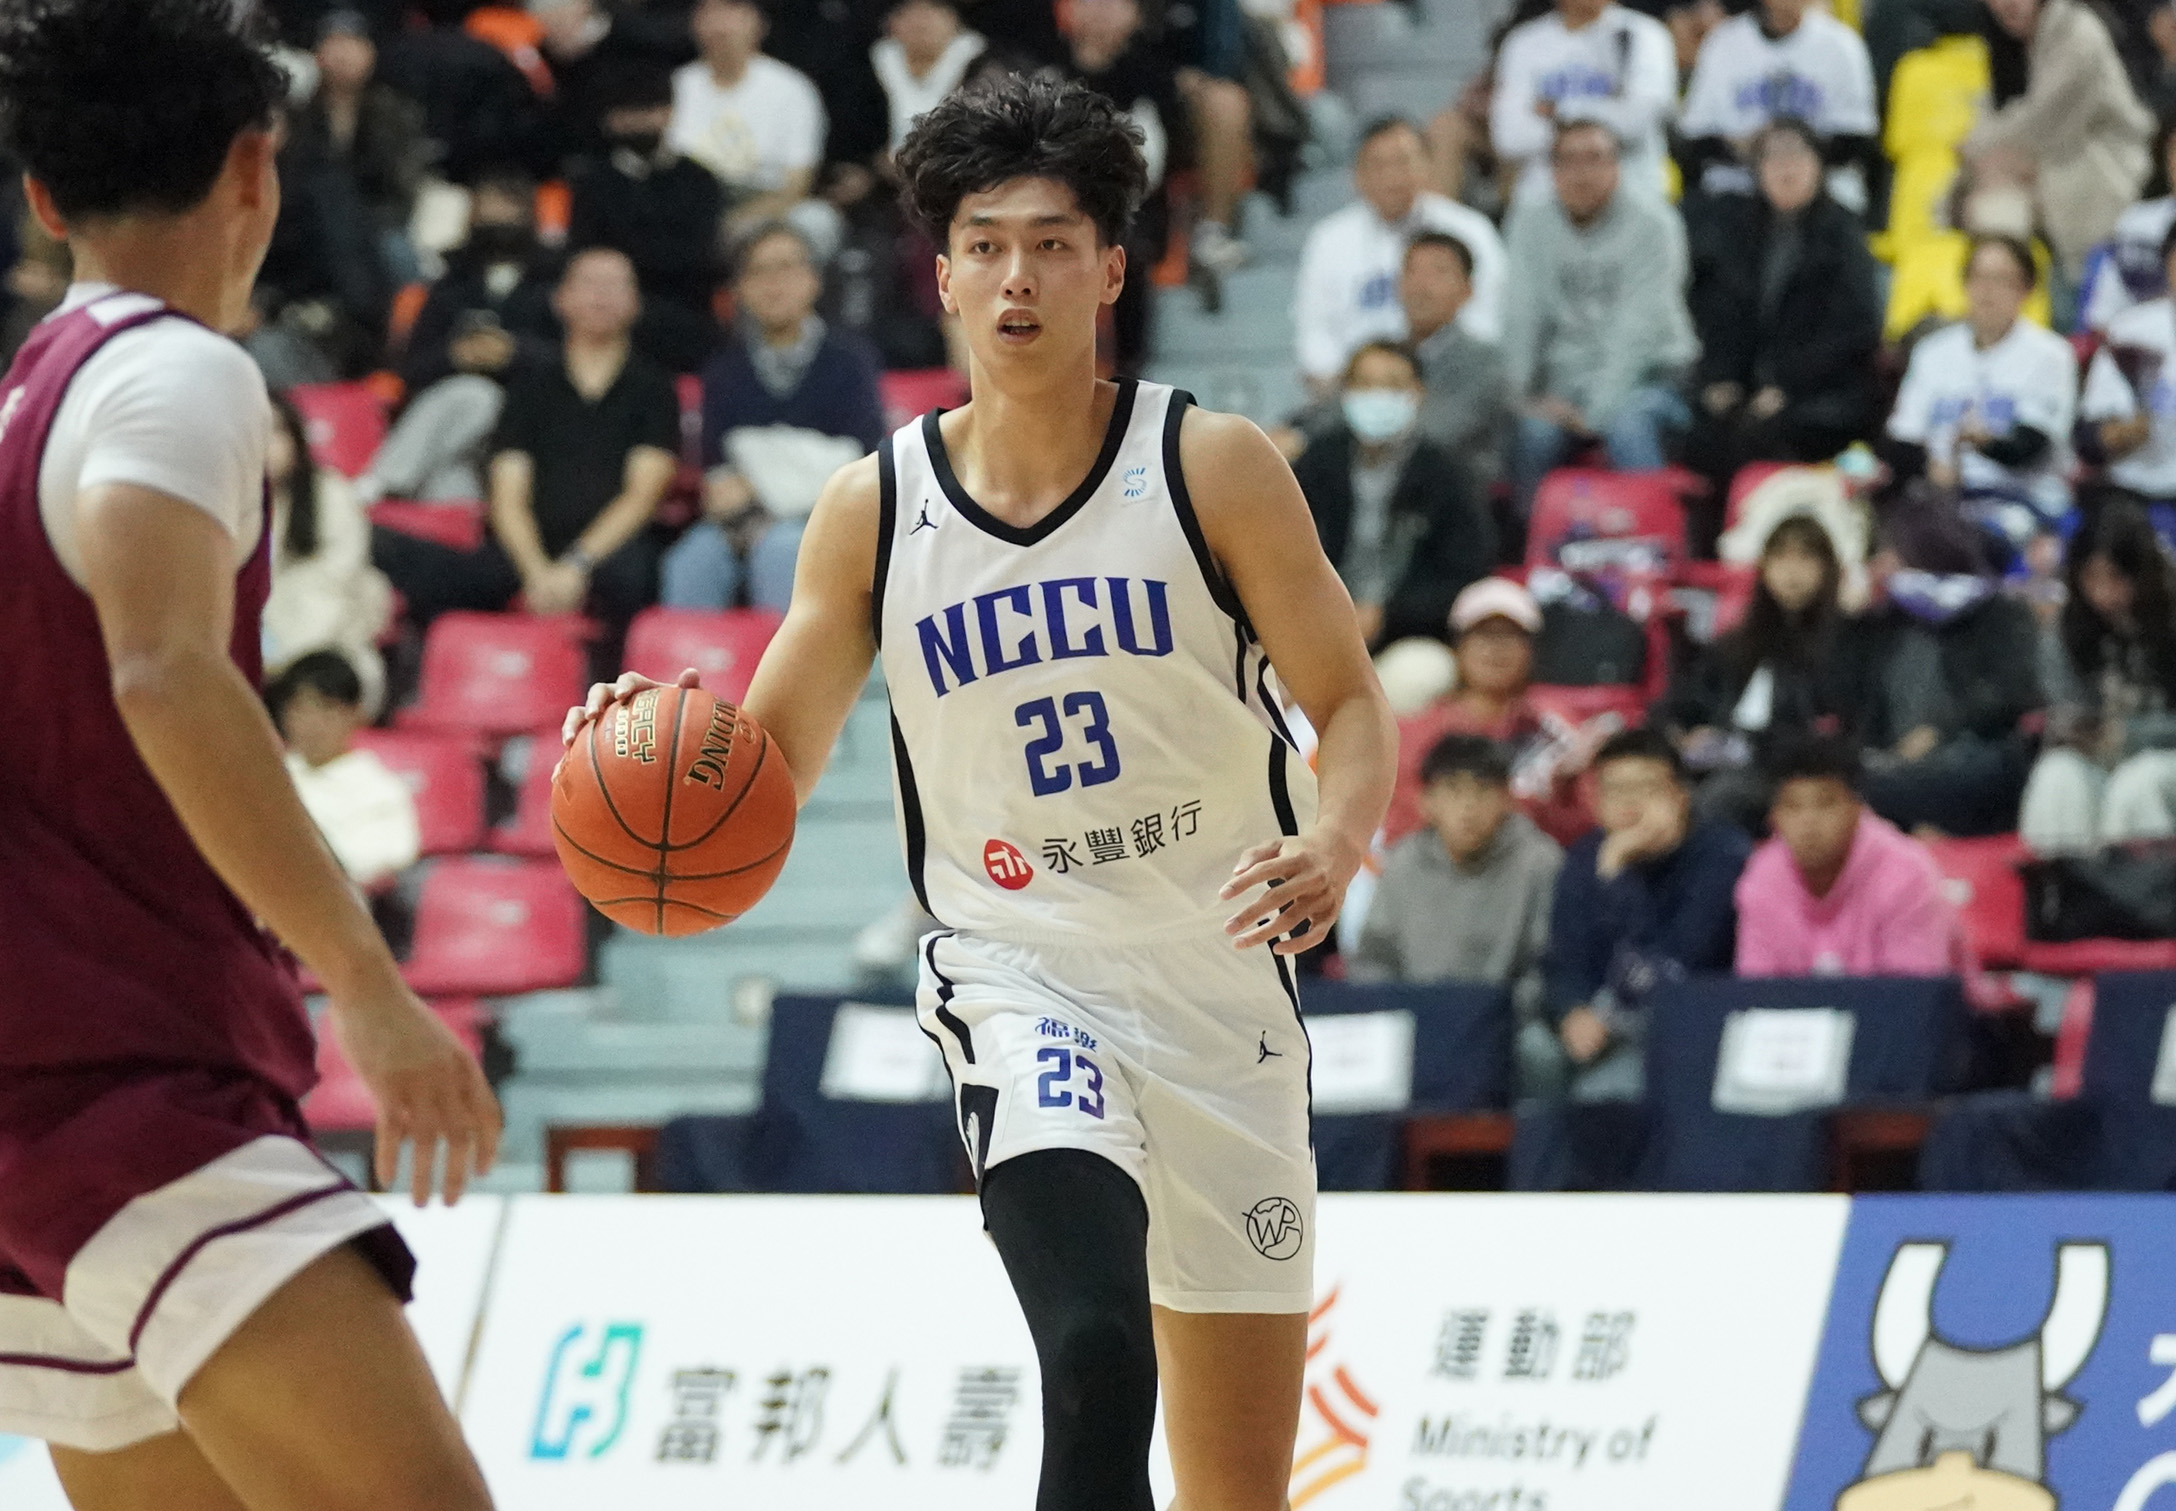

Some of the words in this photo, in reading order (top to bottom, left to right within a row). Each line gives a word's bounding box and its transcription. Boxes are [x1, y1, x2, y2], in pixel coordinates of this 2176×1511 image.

[915, 577, 1174, 698] NCCU
[1014, 691, 1121, 797] 23
[1042, 799, 1202, 874] 永豐銀行
[1036, 1047, 1105, 1120] 23
[1427, 1309, 1637, 1380] 運動部
[653, 1365, 1024, 1468] 富邦人壽
[1410, 1412, 1597, 1470] Ministry
[1604, 1413, 1660, 1461] of
